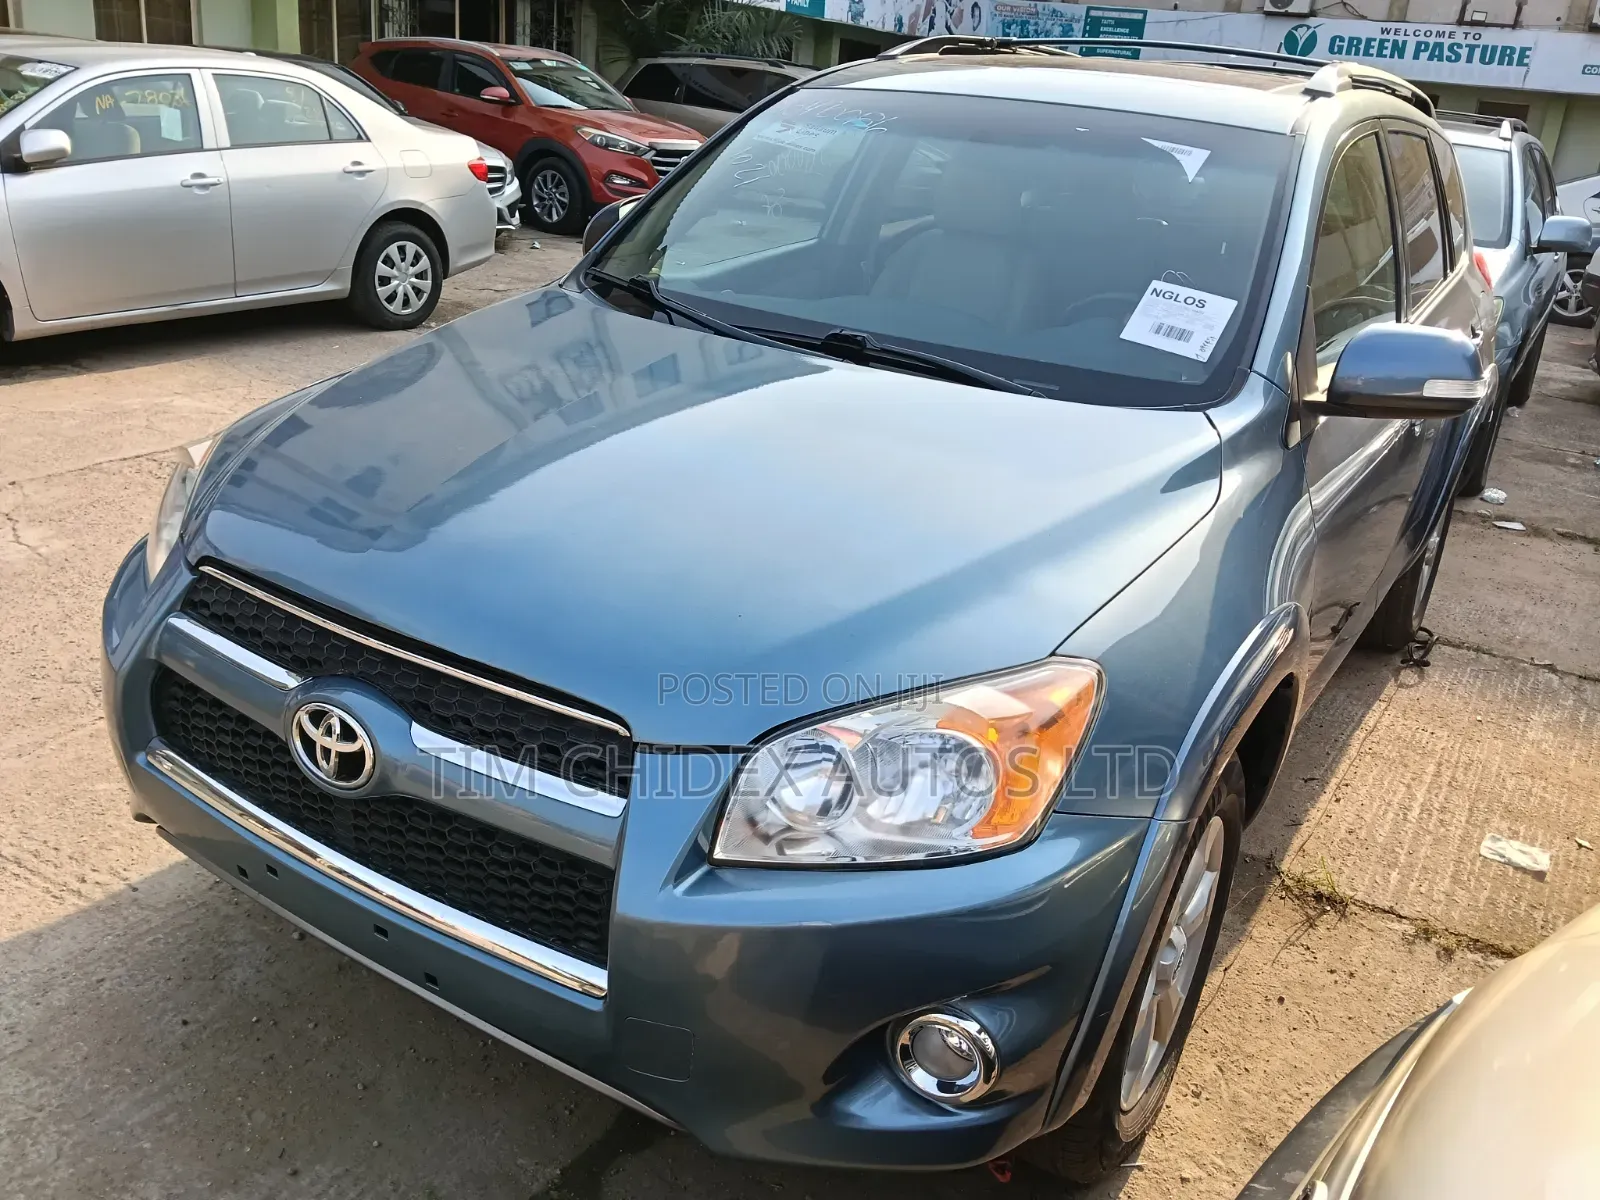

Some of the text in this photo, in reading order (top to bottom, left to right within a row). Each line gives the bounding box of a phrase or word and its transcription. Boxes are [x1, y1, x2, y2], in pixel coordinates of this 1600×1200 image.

[1100, 26, 1130, 34] EXCELLENCE
[1380, 26, 1483, 41] WELCOME TO
[1096, 48, 1132, 56] SUPERNATURAL
[1328, 34, 1533, 68] GREEN PASTURE
[1150, 287, 1207, 309] NGLOS
